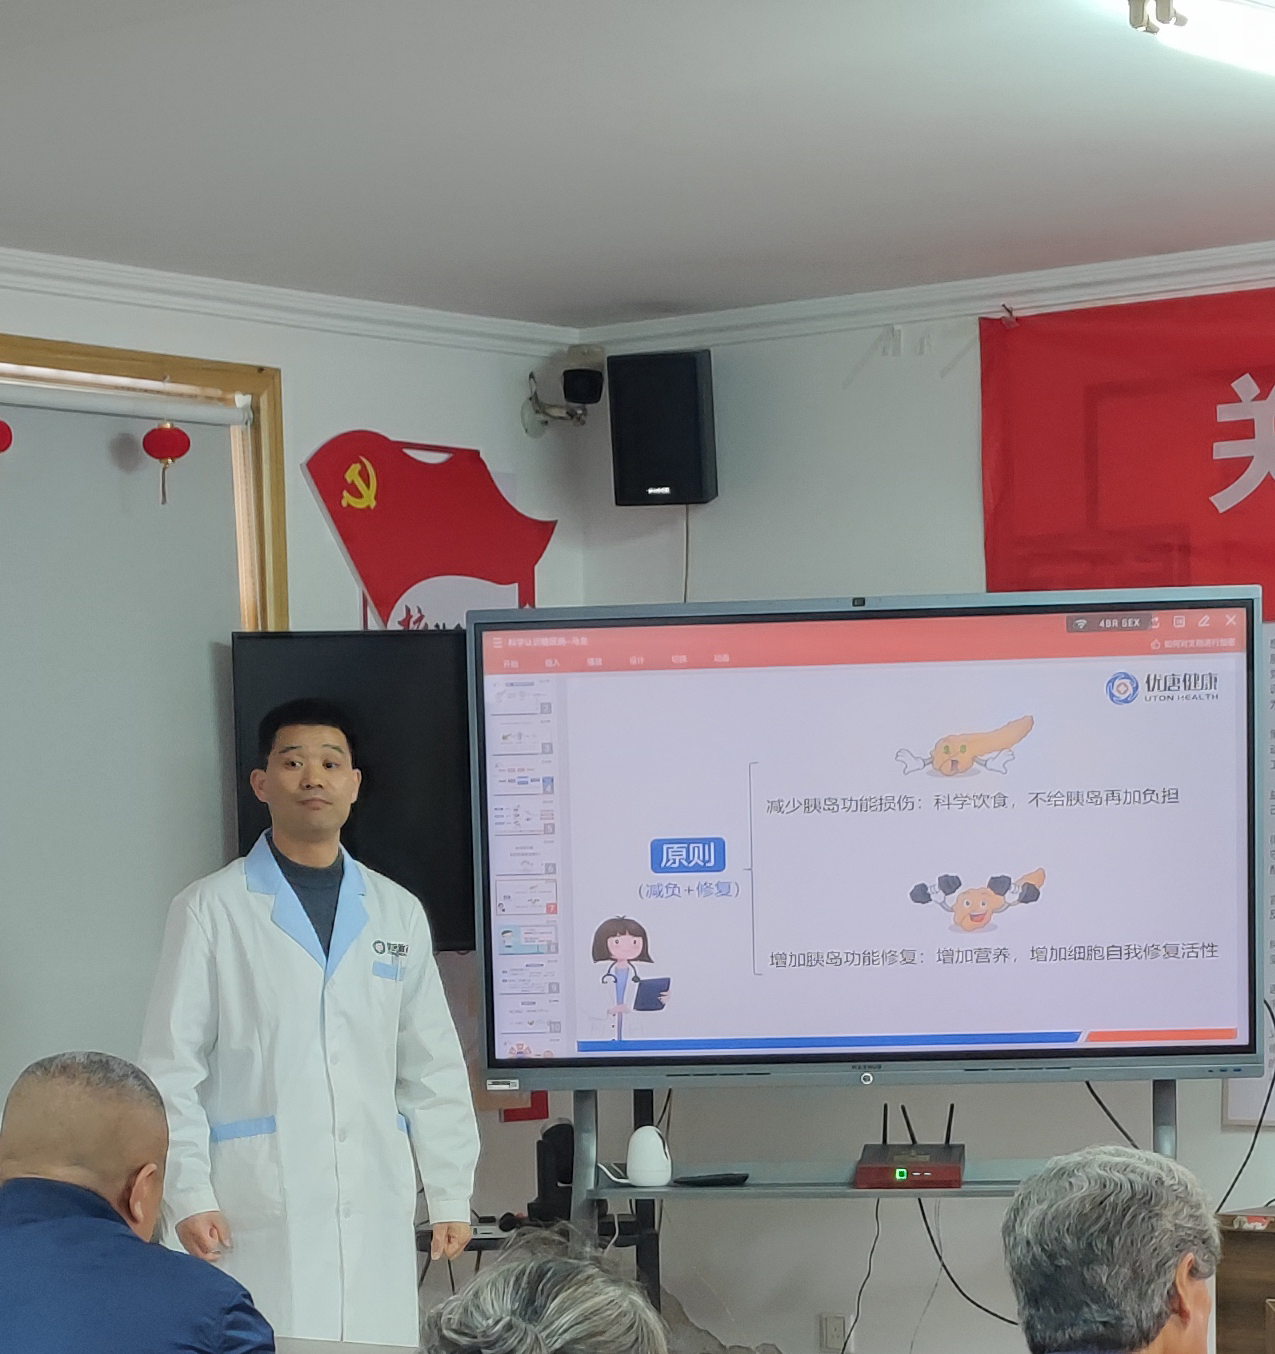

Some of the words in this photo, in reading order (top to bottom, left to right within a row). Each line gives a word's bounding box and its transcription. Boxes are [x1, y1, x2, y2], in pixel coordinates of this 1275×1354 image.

[1145, 672, 1218, 692] 优唐健康
[660, 841, 715, 869] 原则
